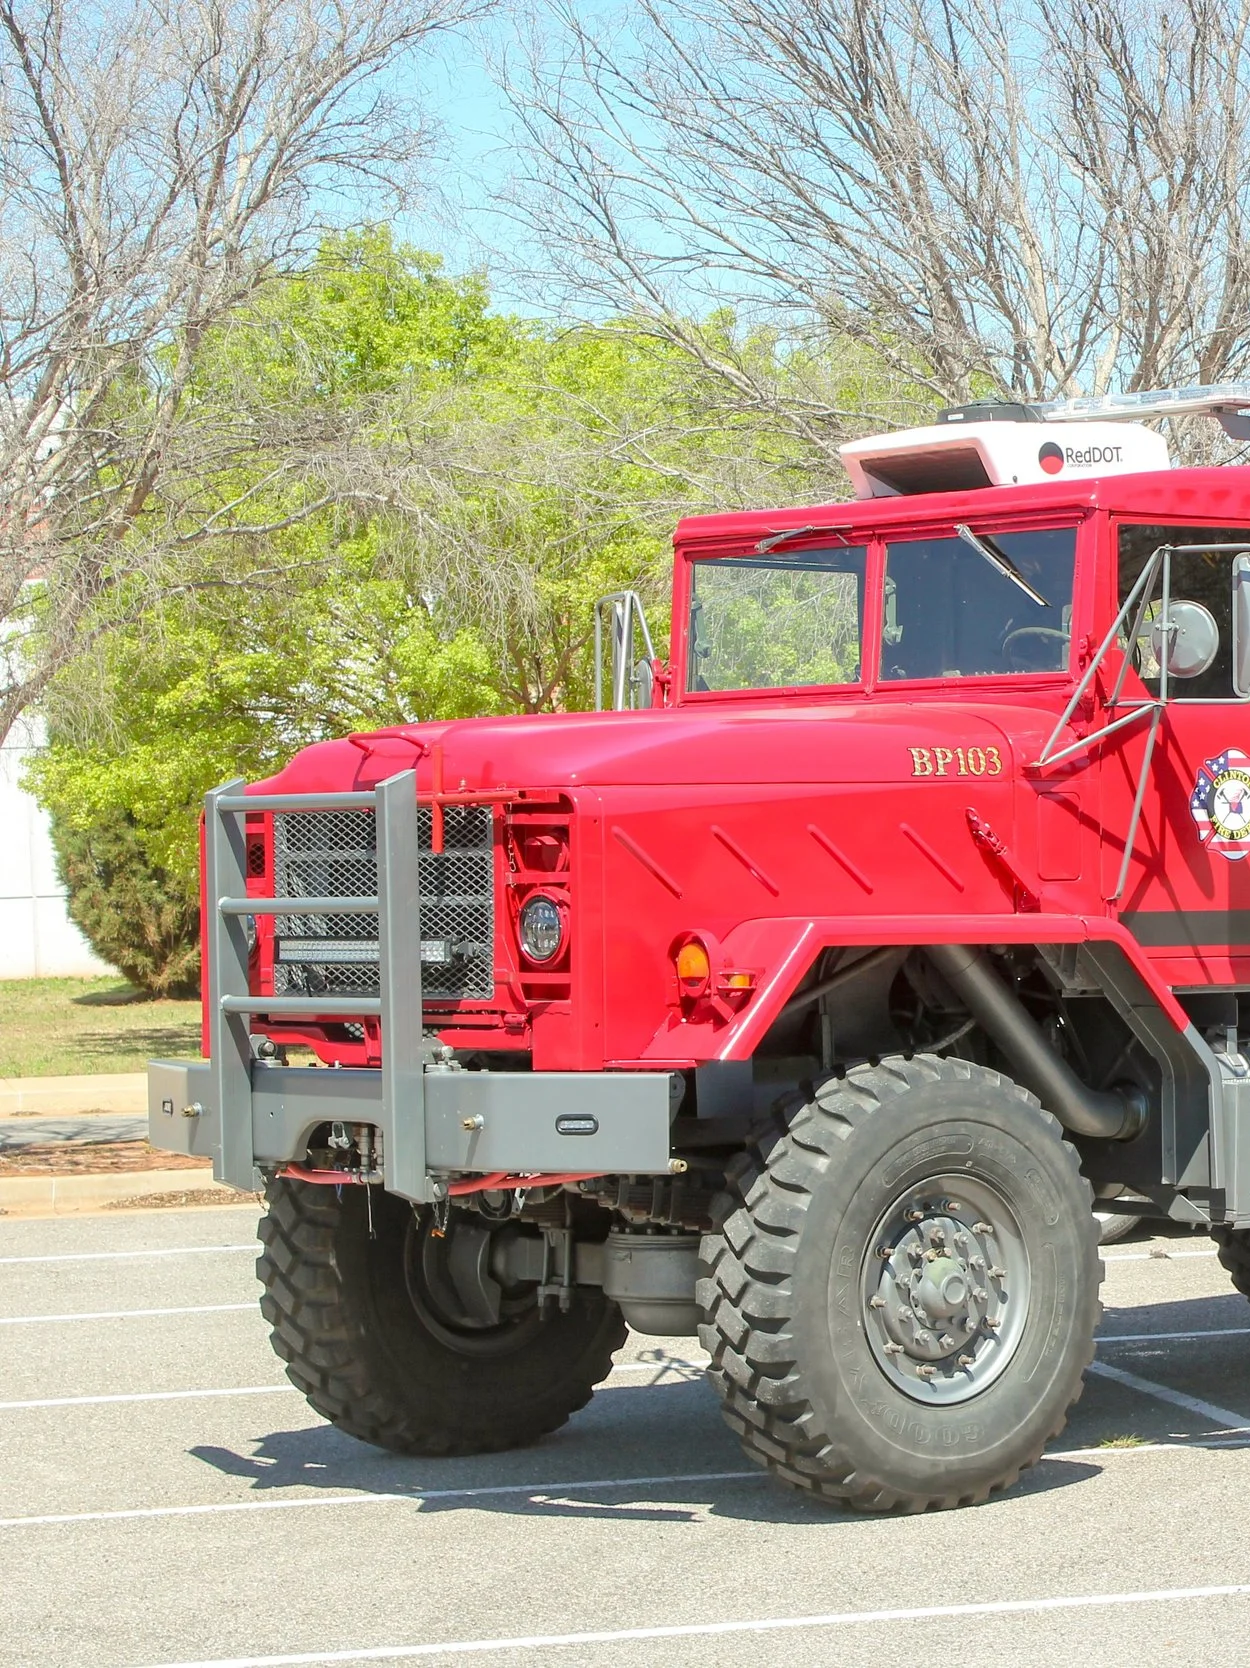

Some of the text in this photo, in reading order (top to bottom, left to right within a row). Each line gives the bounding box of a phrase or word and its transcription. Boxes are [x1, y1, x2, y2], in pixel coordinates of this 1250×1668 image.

[1066, 446, 1122, 464] RedDOT
[907, 746, 1003, 776] BP103
[1210, 814, 1231, 839] FIRE
